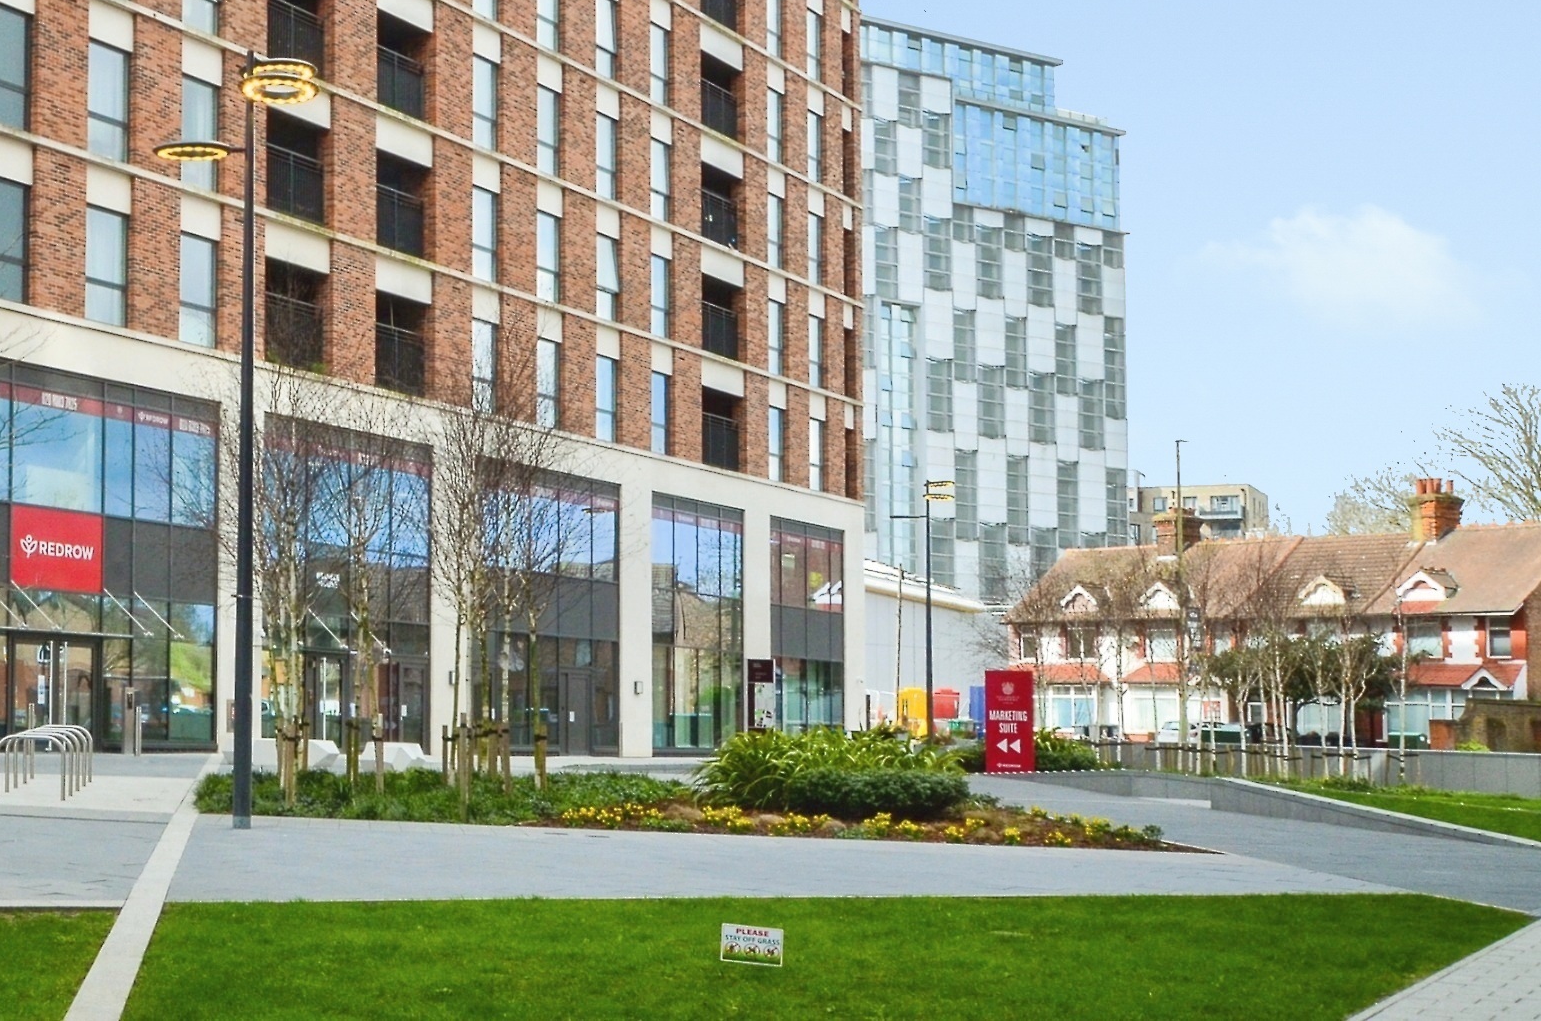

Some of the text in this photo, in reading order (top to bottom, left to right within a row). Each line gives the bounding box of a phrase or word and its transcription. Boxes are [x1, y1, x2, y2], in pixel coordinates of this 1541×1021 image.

[39, 540, 94, 561] REDROW
[989, 710, 1028, 722] MARKETING
[999, 723, 1018, 734] SUITE
[736, 928, 770, 937] PLEASE
[726, 934, 741, 942] STAY
[757, 938, 780, 946] GRASS
